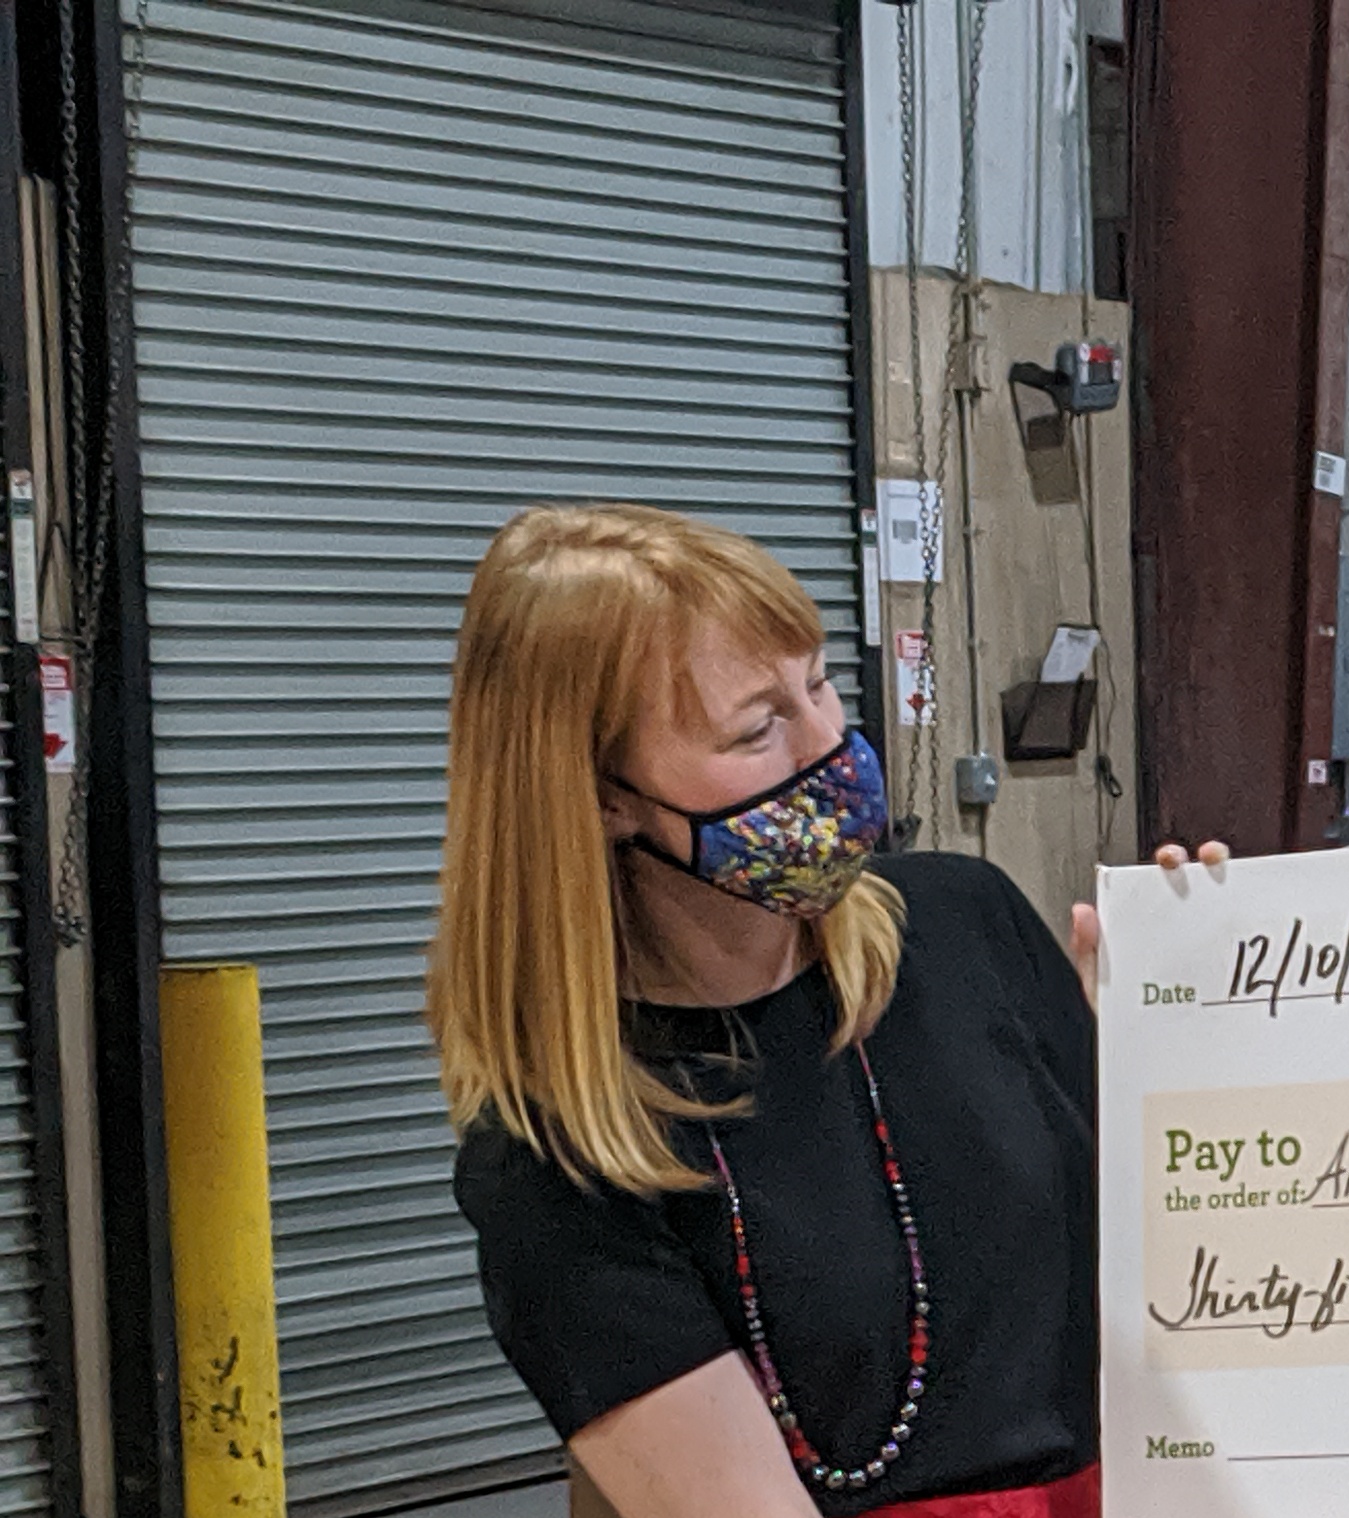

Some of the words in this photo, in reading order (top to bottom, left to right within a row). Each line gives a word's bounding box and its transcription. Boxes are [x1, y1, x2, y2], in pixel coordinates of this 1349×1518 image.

[1142, 983, 1196, 1005] Date
[1165, 1130, 1245, 1181] Pay
[1257, 1130, 1300, 1166] to
[1165, 1185, 1201, 1212] the
[1207, 1182, 1270, 1210] order
[1145, 1435, 1215, 1458] Memo
